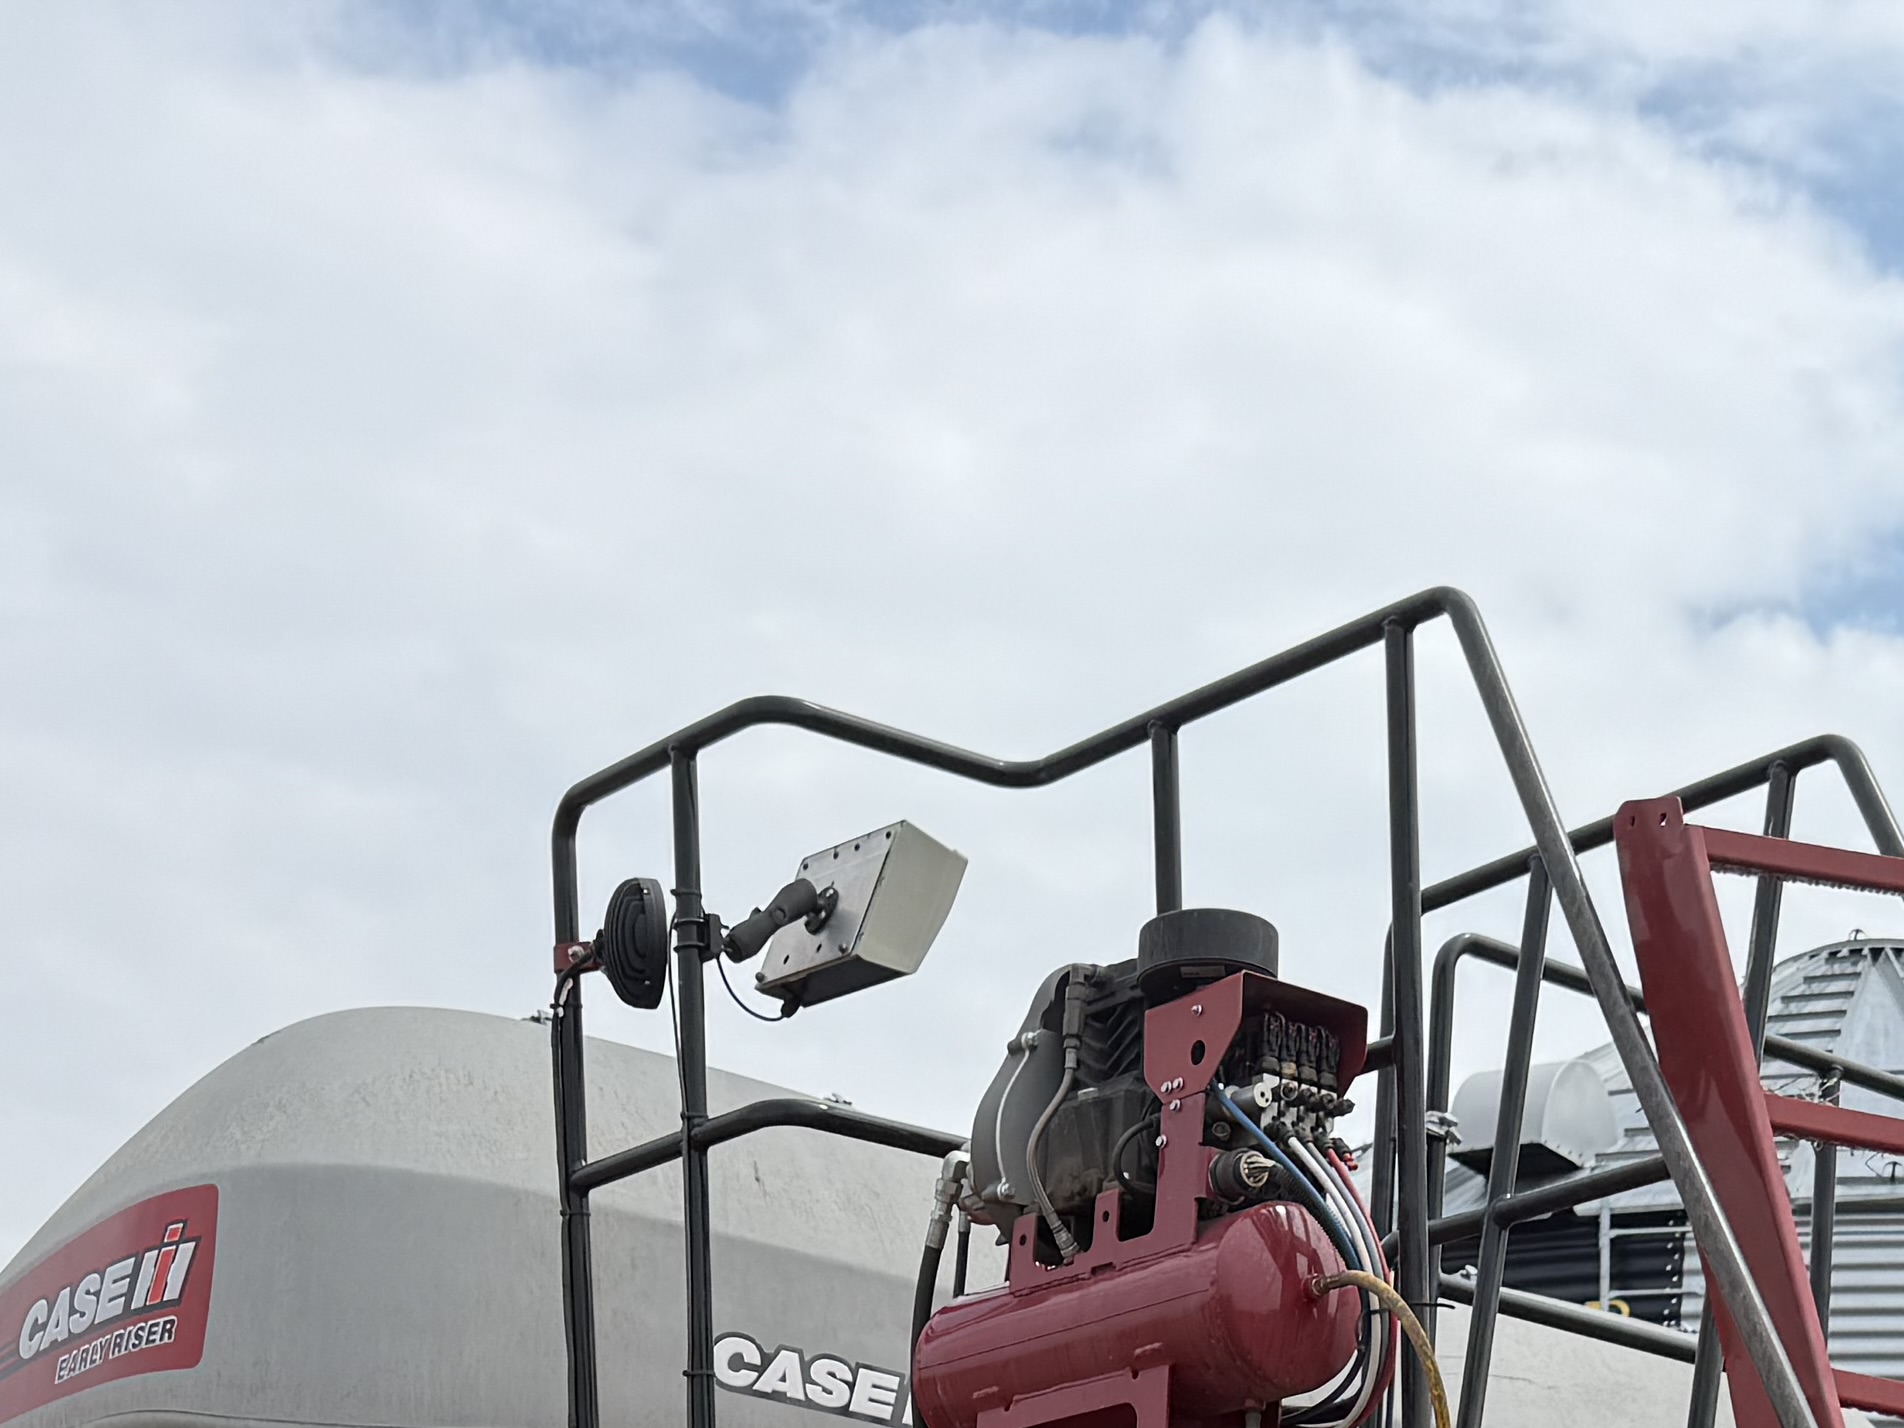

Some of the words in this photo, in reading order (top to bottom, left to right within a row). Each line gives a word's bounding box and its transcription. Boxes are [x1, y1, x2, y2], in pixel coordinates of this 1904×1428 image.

[19, 1257, 136, 1359] CASE
[54, 1335, 111, 1384] EARLY
[109, 1315, 177, 1360] RISER
[713, 1336, 900, 1420] CASE
